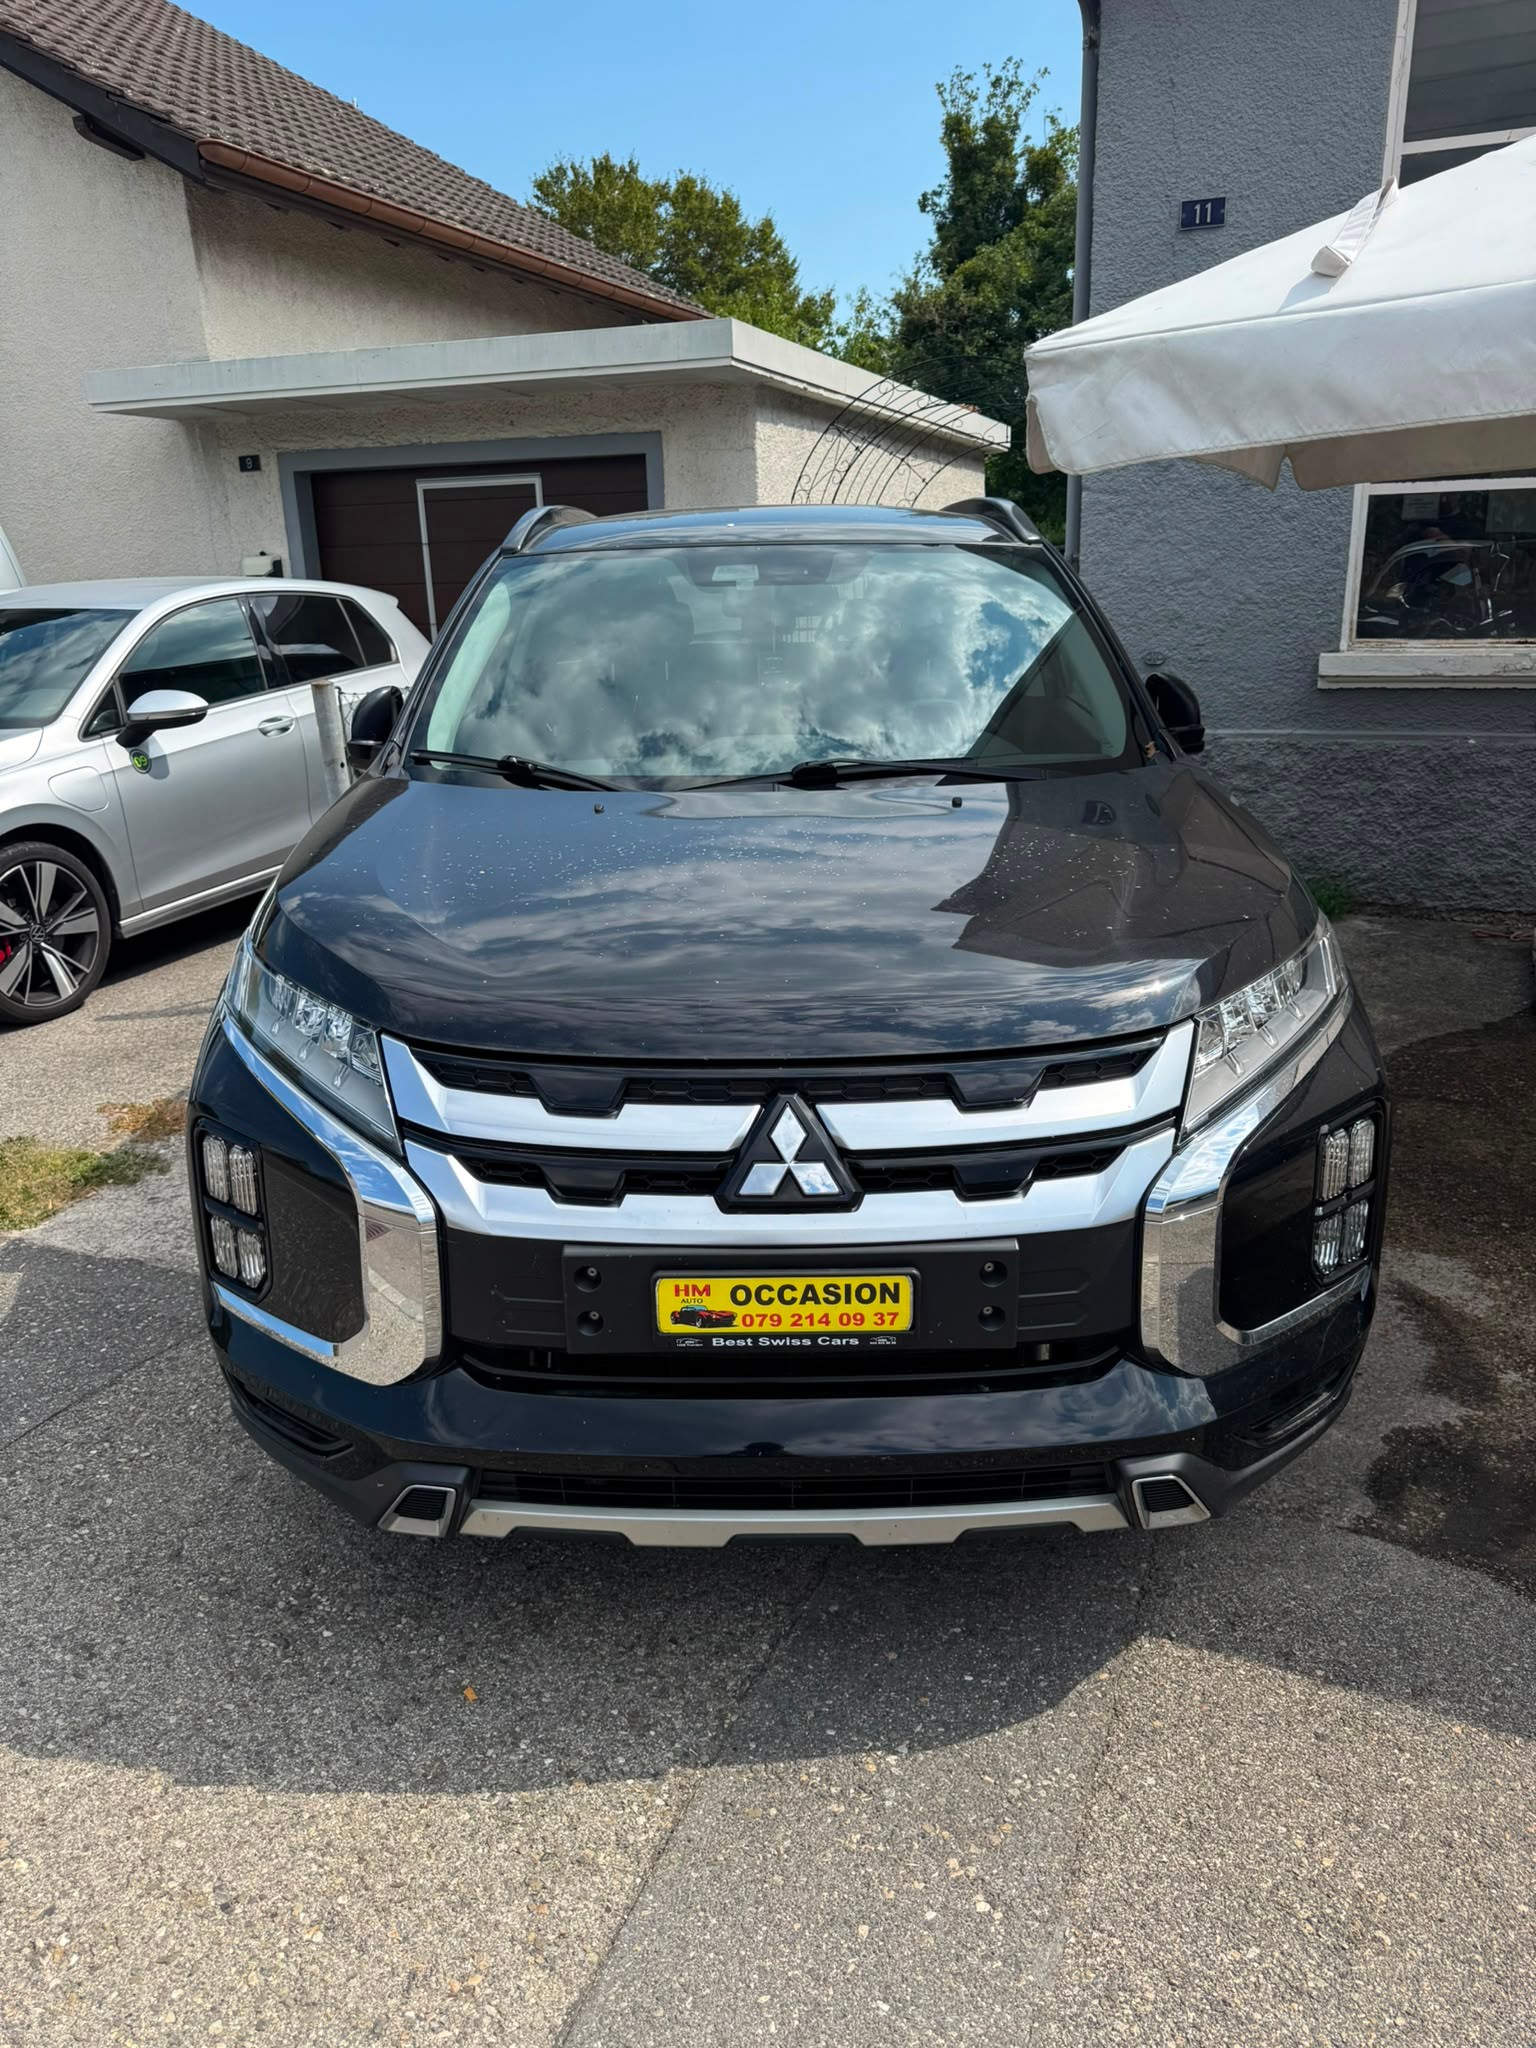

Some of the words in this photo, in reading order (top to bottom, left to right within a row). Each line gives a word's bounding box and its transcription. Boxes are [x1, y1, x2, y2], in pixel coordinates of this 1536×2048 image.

[1194, 202, 1212, 224] 11
[246, 457, 253, 469] 9
[674, 1284, 711, 1297] HM
[730, 1282, 900, 1306] OCCASION
[741, 1313, 782, 1328] 079
[790, 1312, 831, 1327] 214
[838, 1312, 865, 1327] 09
[873, 1311, 899, 1326] 37
[712, 1337, 753, 1346] Best
[758, 1336, 812, 1346] Swiss
[817, 1336, 859, 1346] Cars
